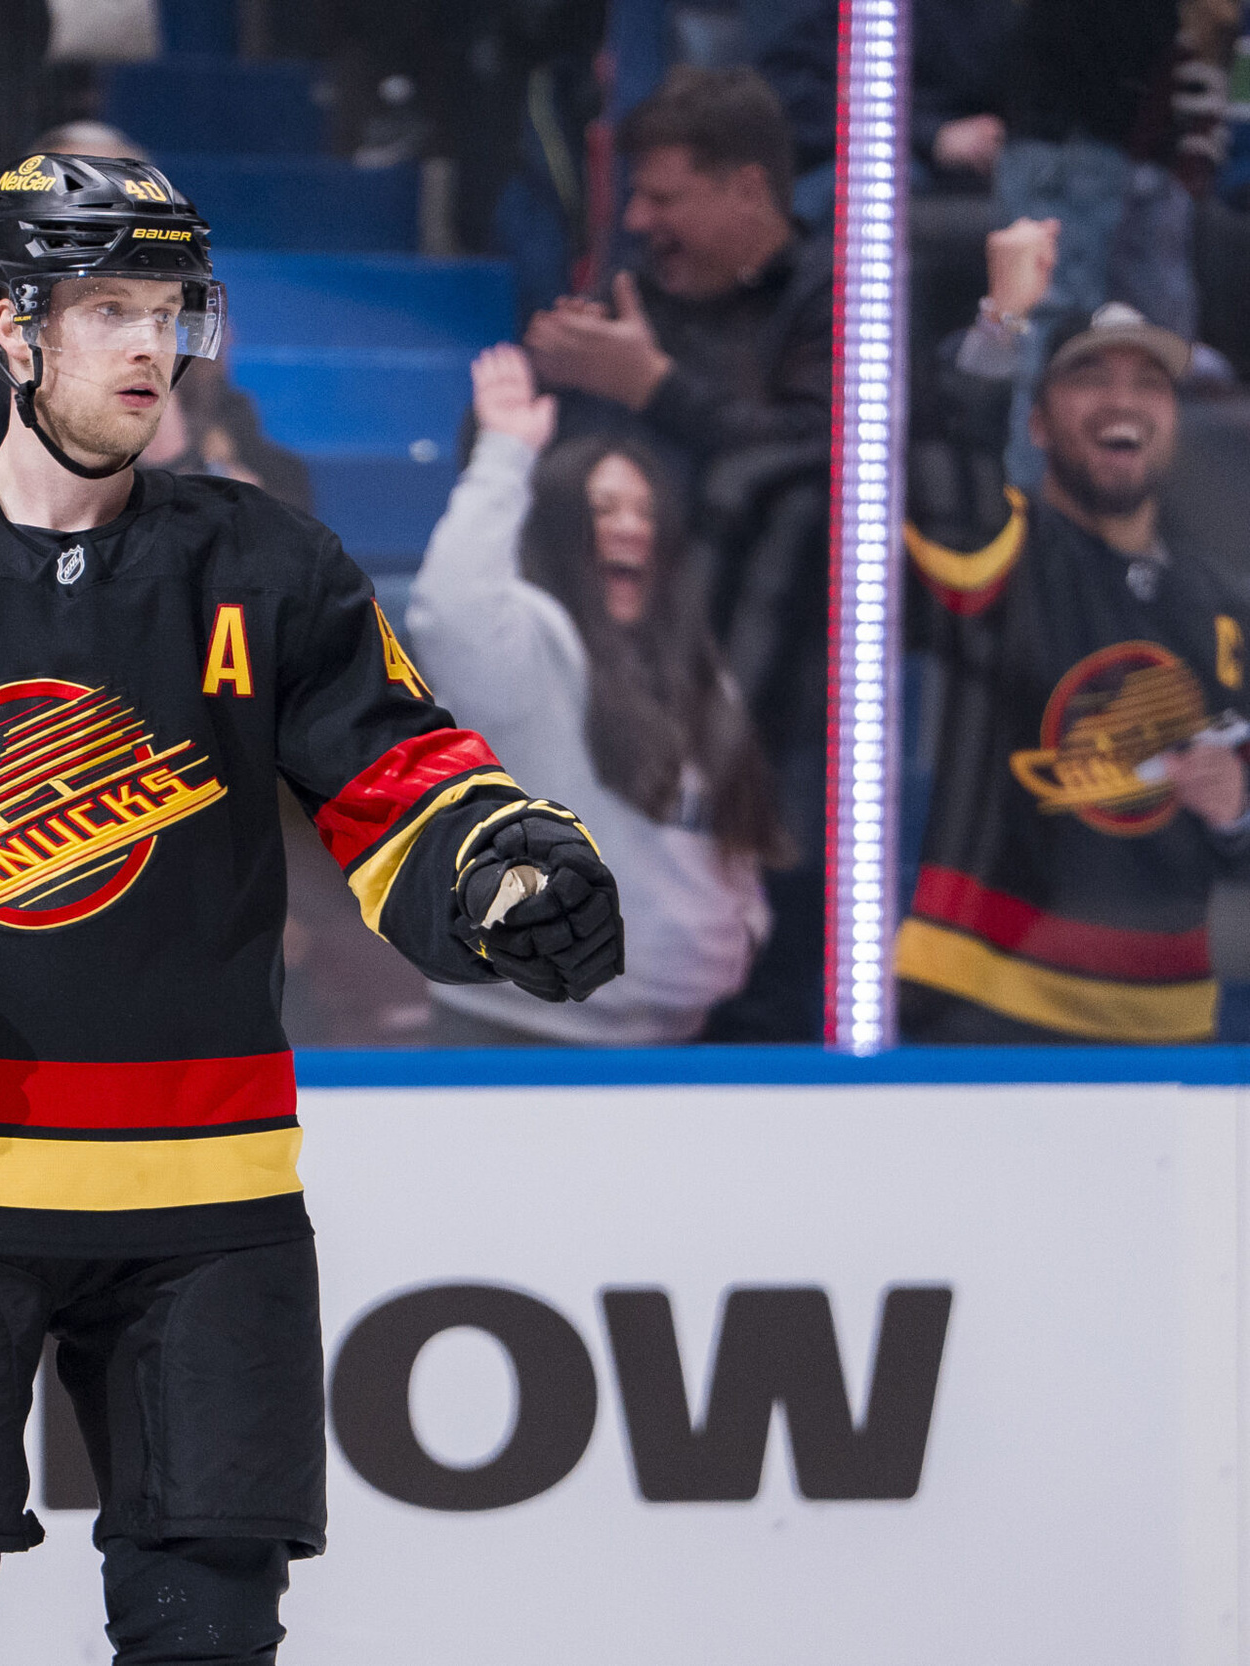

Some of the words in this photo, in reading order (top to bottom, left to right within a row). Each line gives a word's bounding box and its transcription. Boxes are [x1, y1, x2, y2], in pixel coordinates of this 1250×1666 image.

[125, 179, 167, 202] 40
[132, 228, 192, 242] BAUER
[201, 603, 255, 698] A
